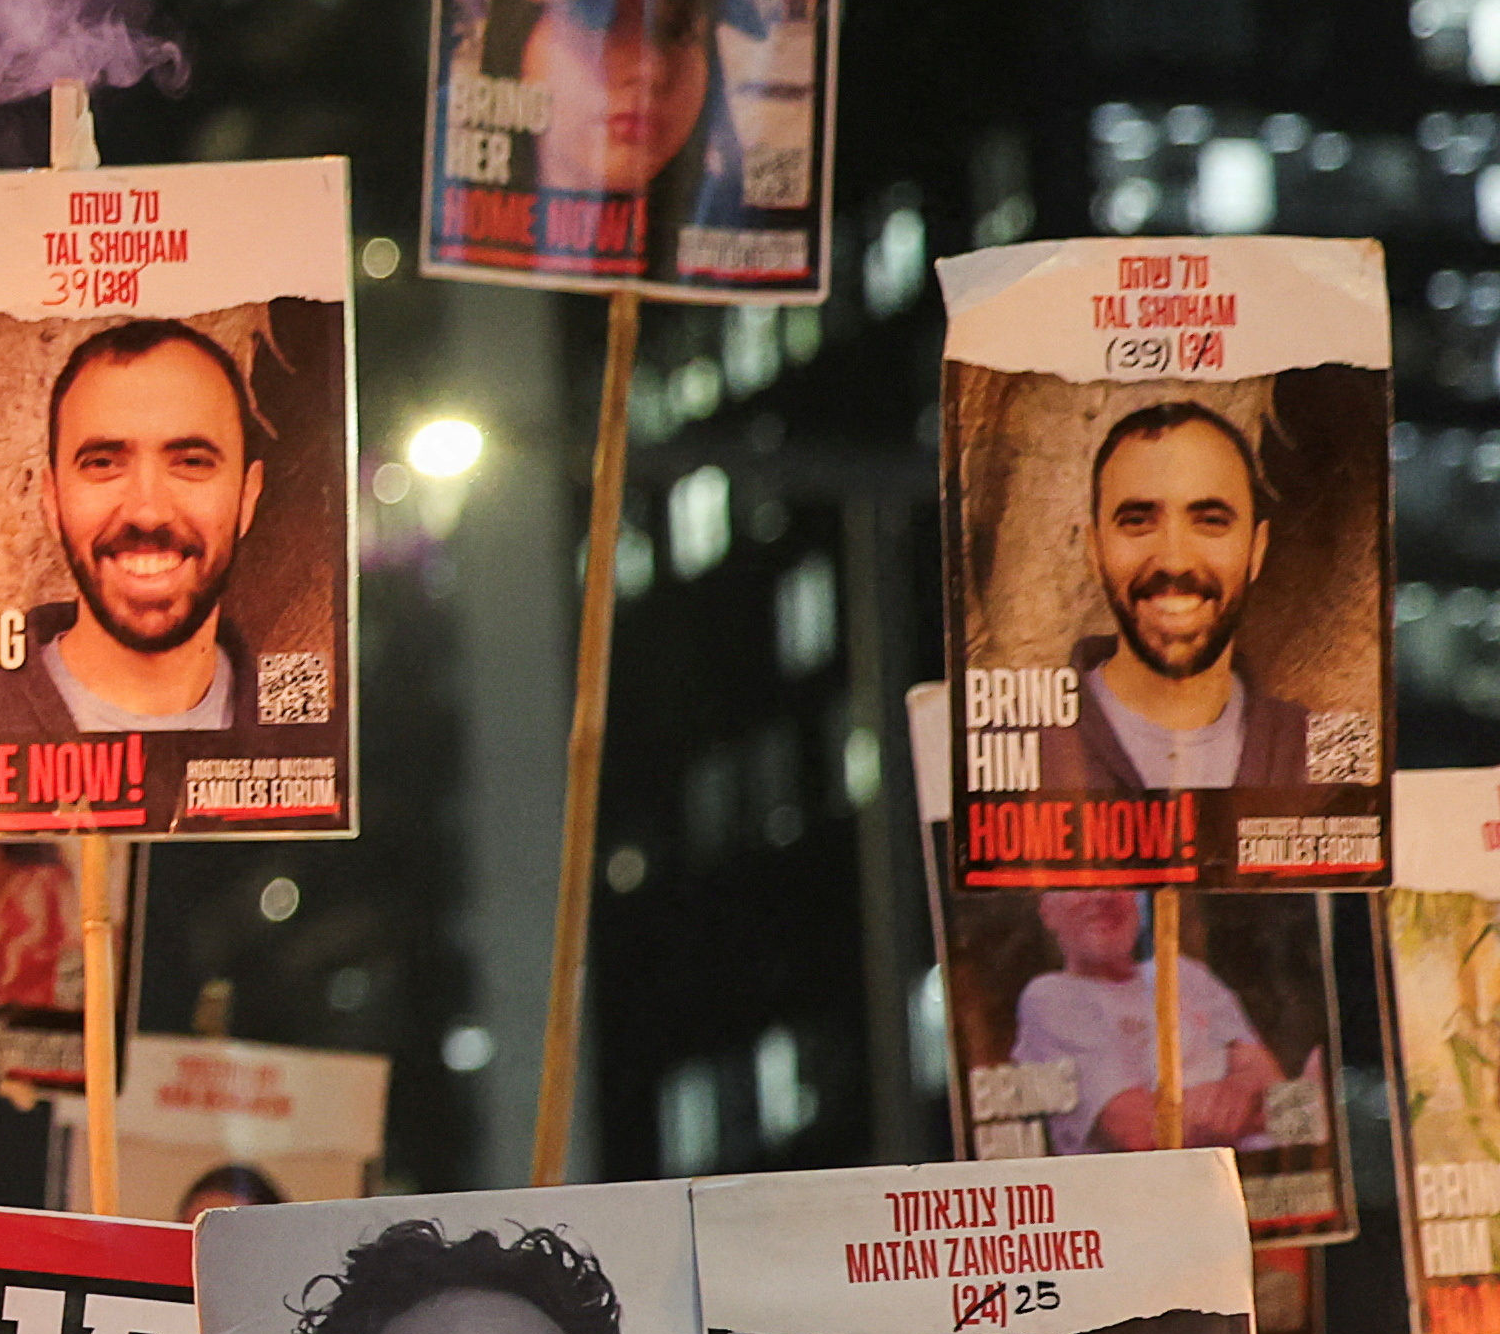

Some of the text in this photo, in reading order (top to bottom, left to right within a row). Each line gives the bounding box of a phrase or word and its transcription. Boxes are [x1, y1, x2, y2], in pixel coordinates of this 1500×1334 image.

[69, 188, 159, 225] טל שהם
[42, 230, 188, 265] TAL SHOHAM
[41, 268, 89, 308] 39
[1091, 293, 1236, 329] TAL SHOHAM
[1105, 337, 1173, 373] (39)
[966, 667, 1080, 728] BRING
[29, 733, 147, 804] NOW!
[967, 730, 1041, 792] HIM
[187, 779, 335, 809] FAMILIES FORUM
[969, 792, 1196, 861] HOME NOW!
[885, 1184, 1054, 1236] מתן צנגאוקר
[1417, 1162, 1500, 1219] BRIN
[845, 1229, 1104, 1284] MATAN ZANGAUKER
[1014, 1281, 1061, 1315] 25
